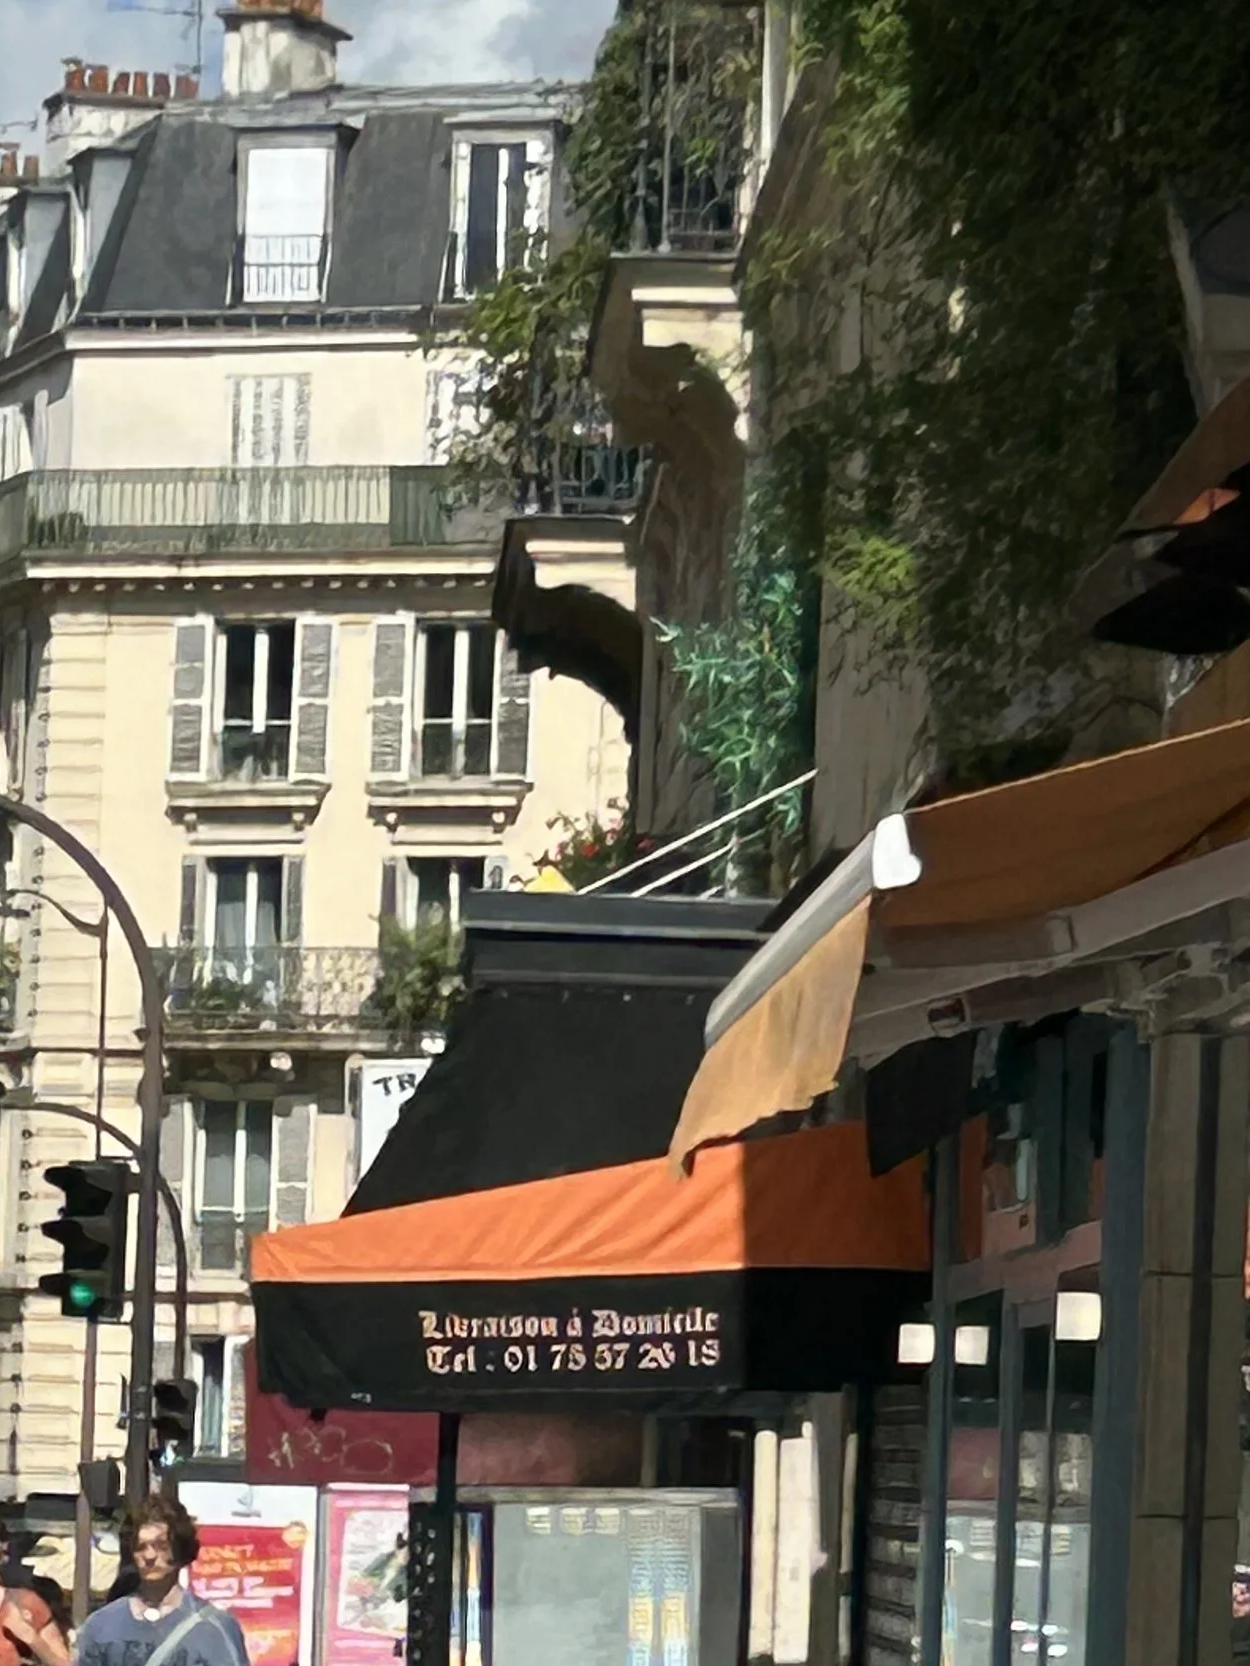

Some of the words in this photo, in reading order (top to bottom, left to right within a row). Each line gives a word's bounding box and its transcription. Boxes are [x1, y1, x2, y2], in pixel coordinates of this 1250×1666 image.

[371, 1072, 417, 1097] TR
[418, 1309, 559, 1339] Livraison
[591, 1306, 720, 1338] Domicile
[503, 1344, 538, 1373] 01
